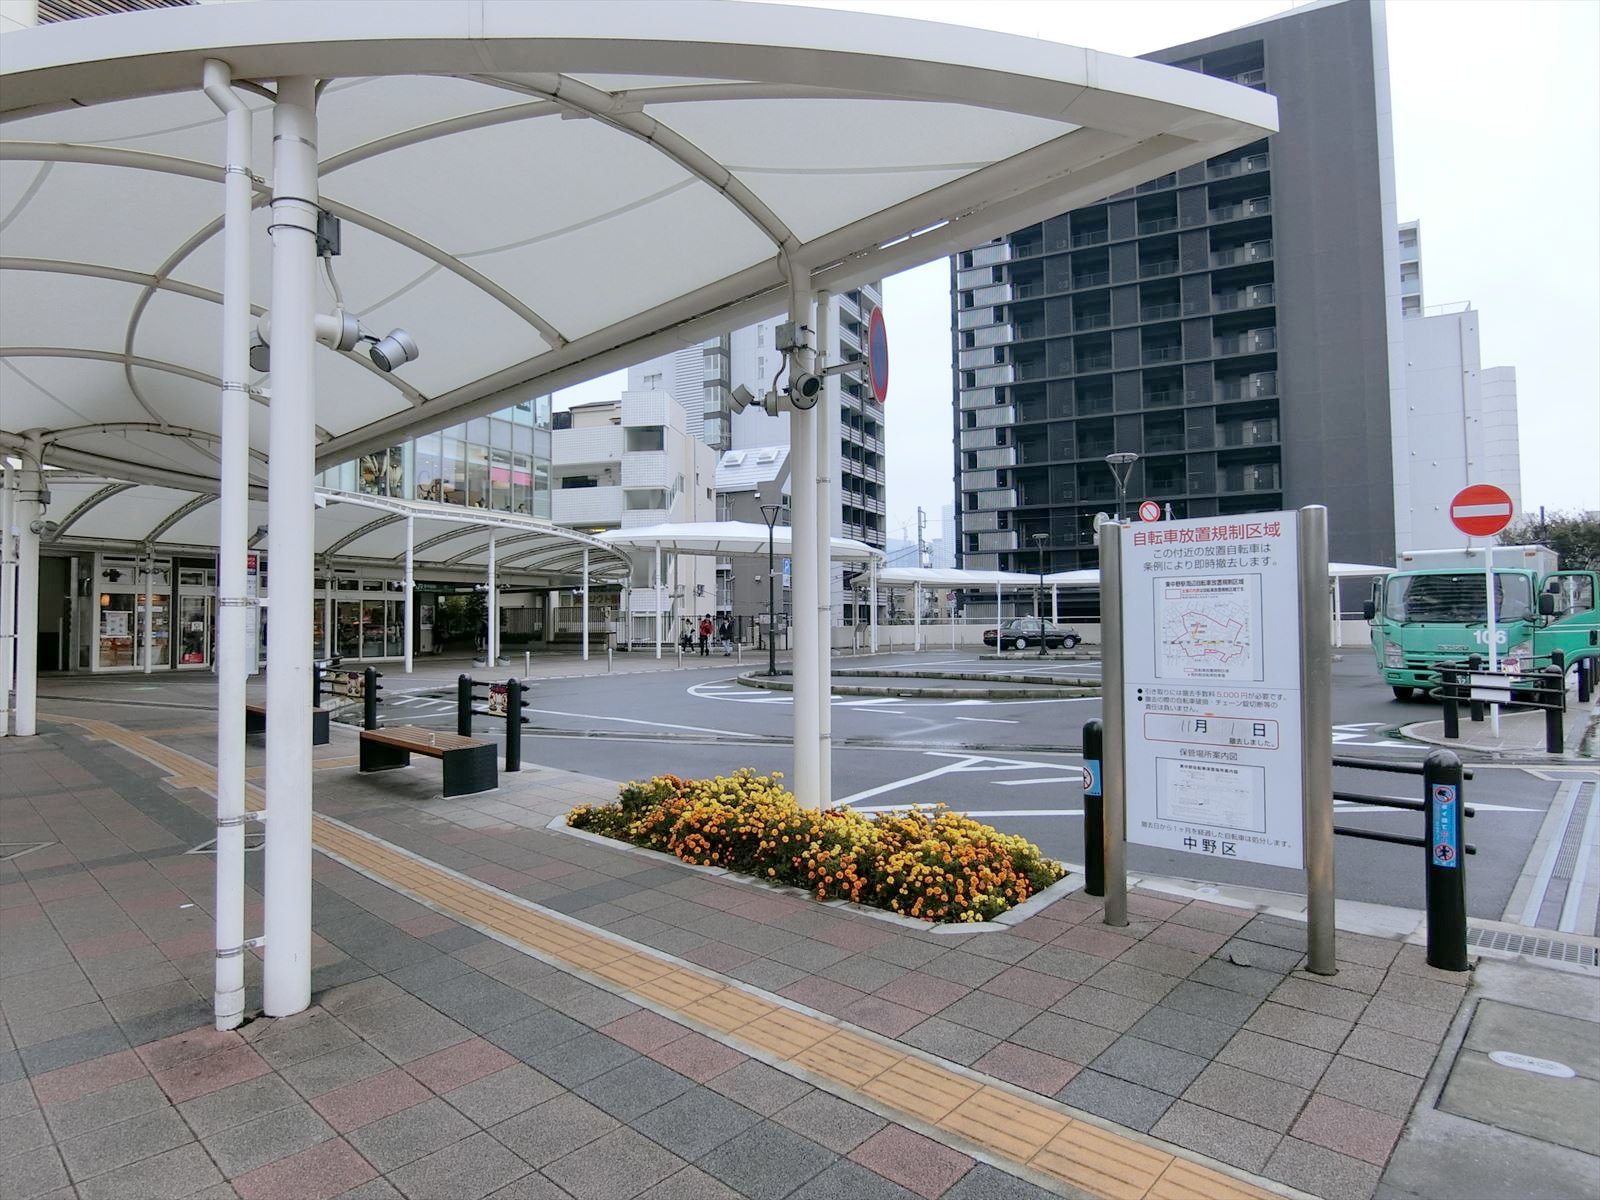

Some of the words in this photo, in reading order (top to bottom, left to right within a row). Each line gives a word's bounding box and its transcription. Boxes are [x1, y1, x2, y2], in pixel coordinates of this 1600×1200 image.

[1134, 522, 1280, 546] 自転車放置規制区域
[1153, 543, 1271, 559] この付近の放置自転車は
[1143, 556, 1277, 571] 条例により即時撤去します。
[1473, 630, 1507, 645] 106
[1179, 748, 1238, 761] 保管場所案内図
[1183, 836, 1238, 856] 中野区
